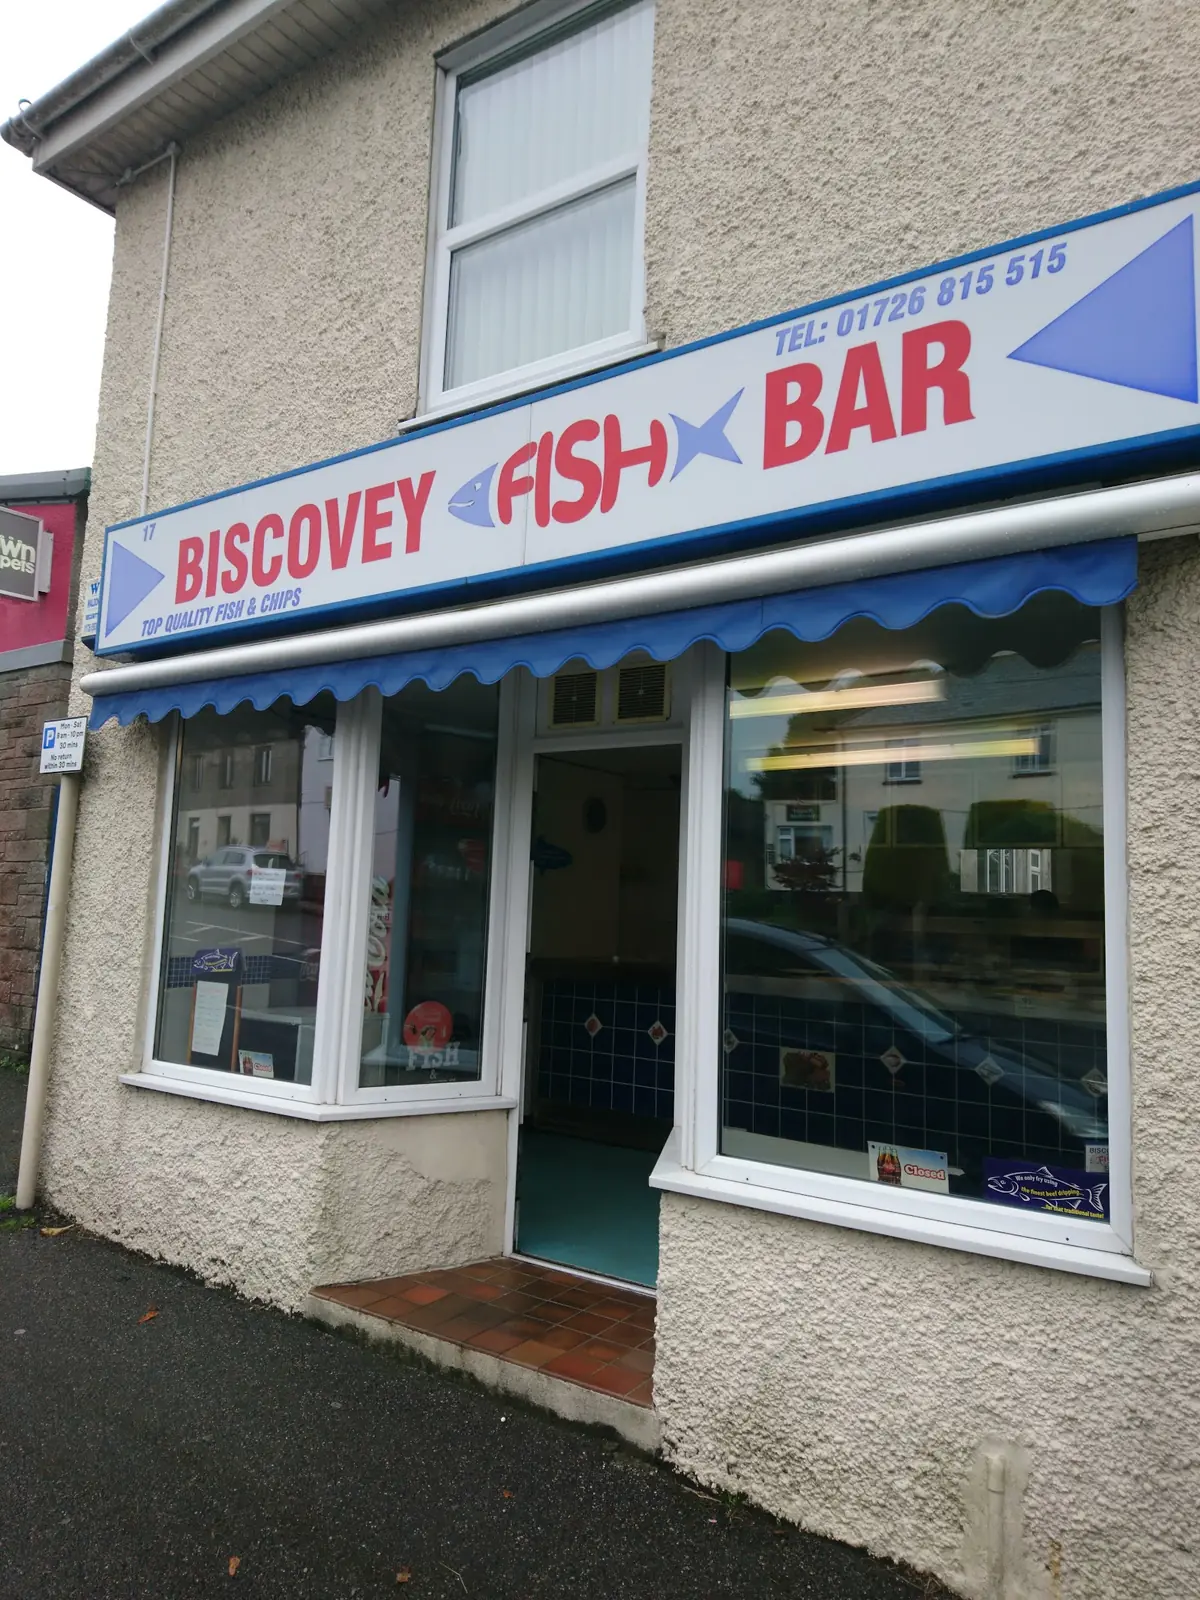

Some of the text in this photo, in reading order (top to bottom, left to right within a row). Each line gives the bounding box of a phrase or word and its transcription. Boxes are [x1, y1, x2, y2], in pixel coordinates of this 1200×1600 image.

[775, 243, 1067, 356] TEL: 01726 815 515
[175, 319, 976, 605] BISCOVEY FISH BAR
[142, 523, 157, 542] 17
[141, 587, 302, 637] TOP QUALITY FISH & CHIPS
[904, 1164, 946, 1181] Closed
[1024, 1174, 1035, 1182] only
[1043, 1178, 1058, 1188] using
